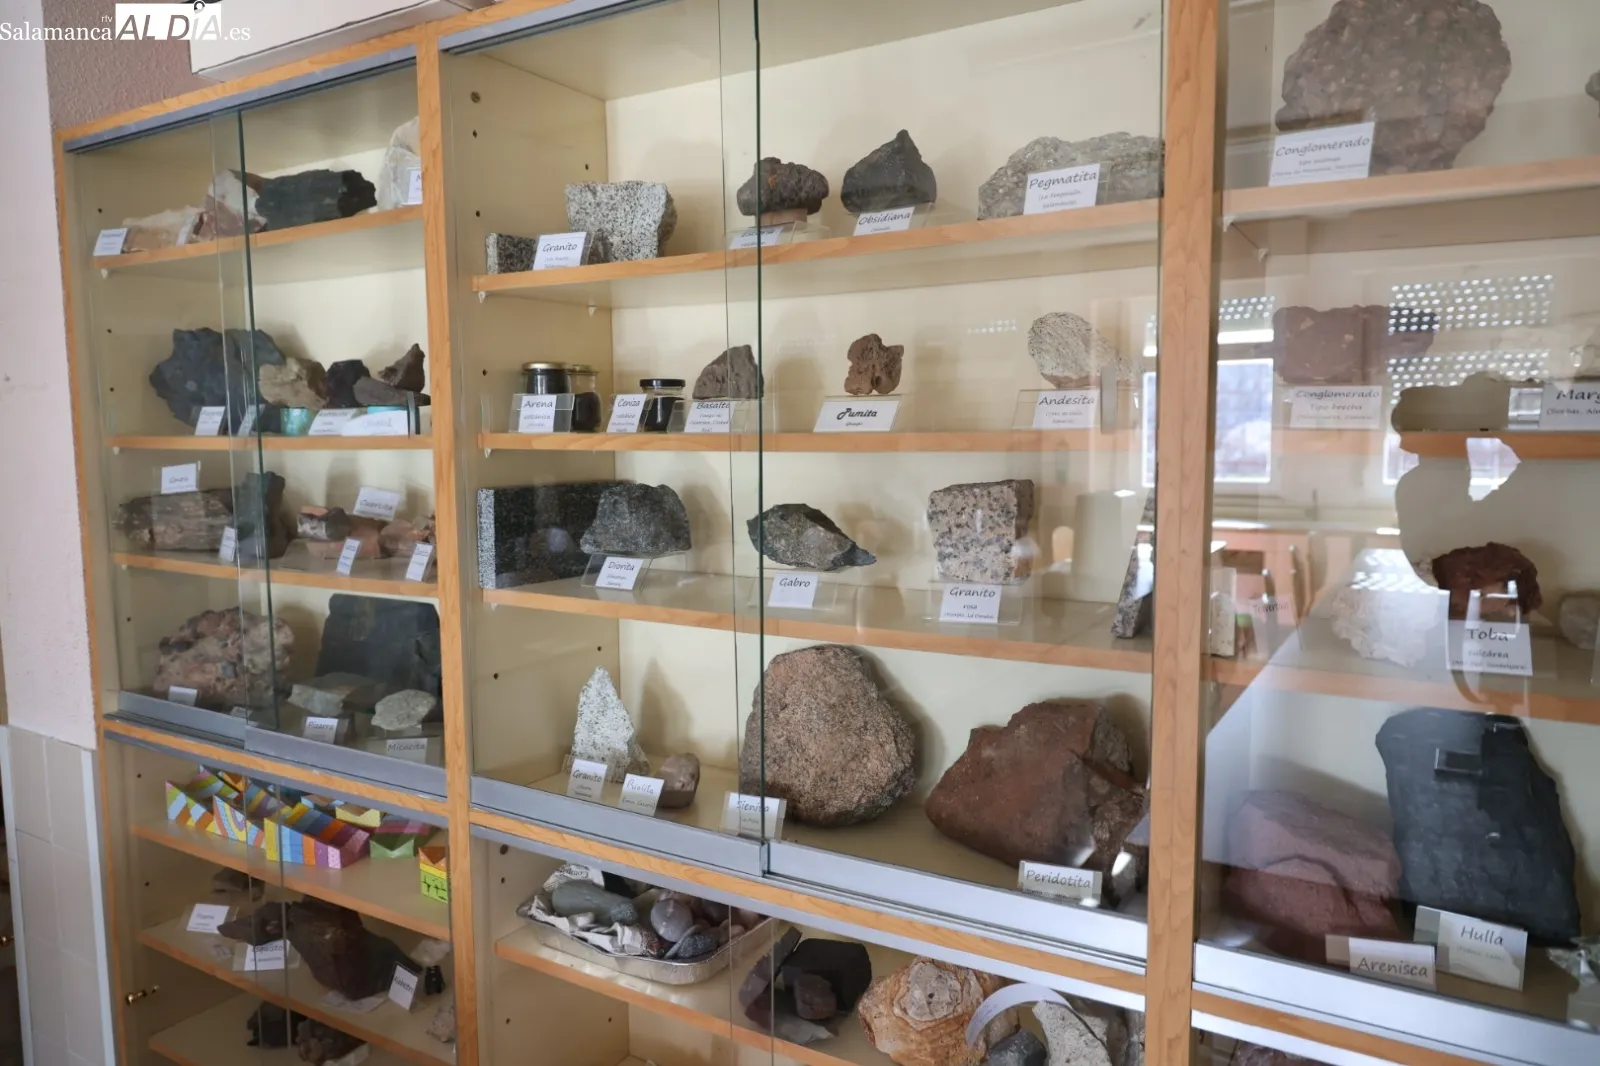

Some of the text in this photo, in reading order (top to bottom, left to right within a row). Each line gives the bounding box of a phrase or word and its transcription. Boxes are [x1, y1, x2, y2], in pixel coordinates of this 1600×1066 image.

[1275, 136, 1370, 157] Conglomerado
[1029, 171, 1097, 190] Pegmatita
[858, 212, 912, 226] Obsidiana
[542, 242, 578, 253] Granito
[1039, 395, 1095, 406] Andesita
[1295, 389, 1380, 400] Conglomerado
[523, 400, 553, 409] Arena
[617, 398, 640, 407] Ceniza
[696, 401, 730, 410] Basalto
[836, 408, 878, 421] Pumita
[607, 561, 635, 572] Diorita
[778, 577, 811, 588] Gabro
[949, 586, 996, 598] Granito
[1466, 627, 1509, 642] Toba
[572, 769, 603, 783] Granito
[737, 800, 770, 813] Sienia
[1026, 869, 1091, 889] Peridotita
[1460, 925, 1505, 946] Hulla
[1357, 956, 1429, 978] Arenisca
